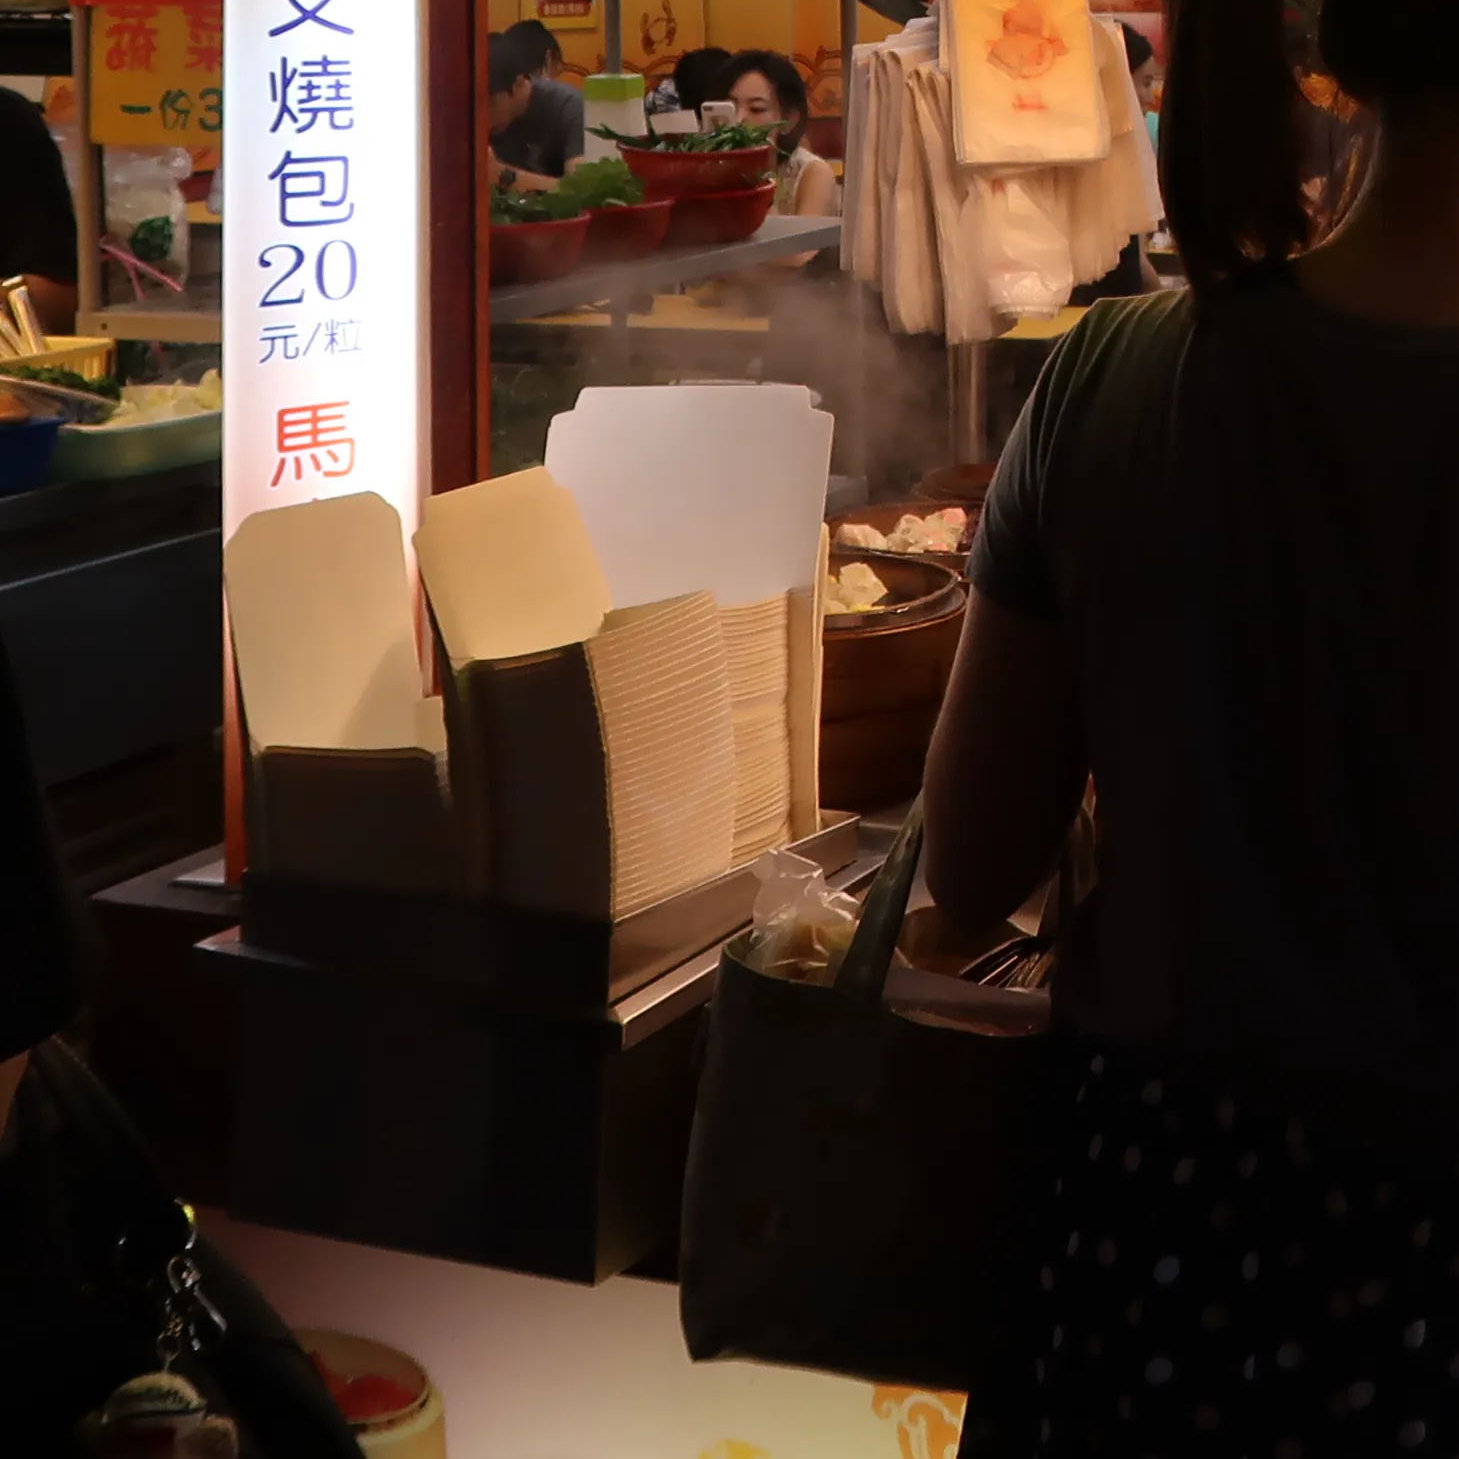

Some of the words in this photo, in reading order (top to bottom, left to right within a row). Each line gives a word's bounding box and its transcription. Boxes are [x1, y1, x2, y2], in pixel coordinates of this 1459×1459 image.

[257, 239, 357, 308] 20
[258, 318, 363, 364] 元/粒
[270, 400, 356, 501] 馬
